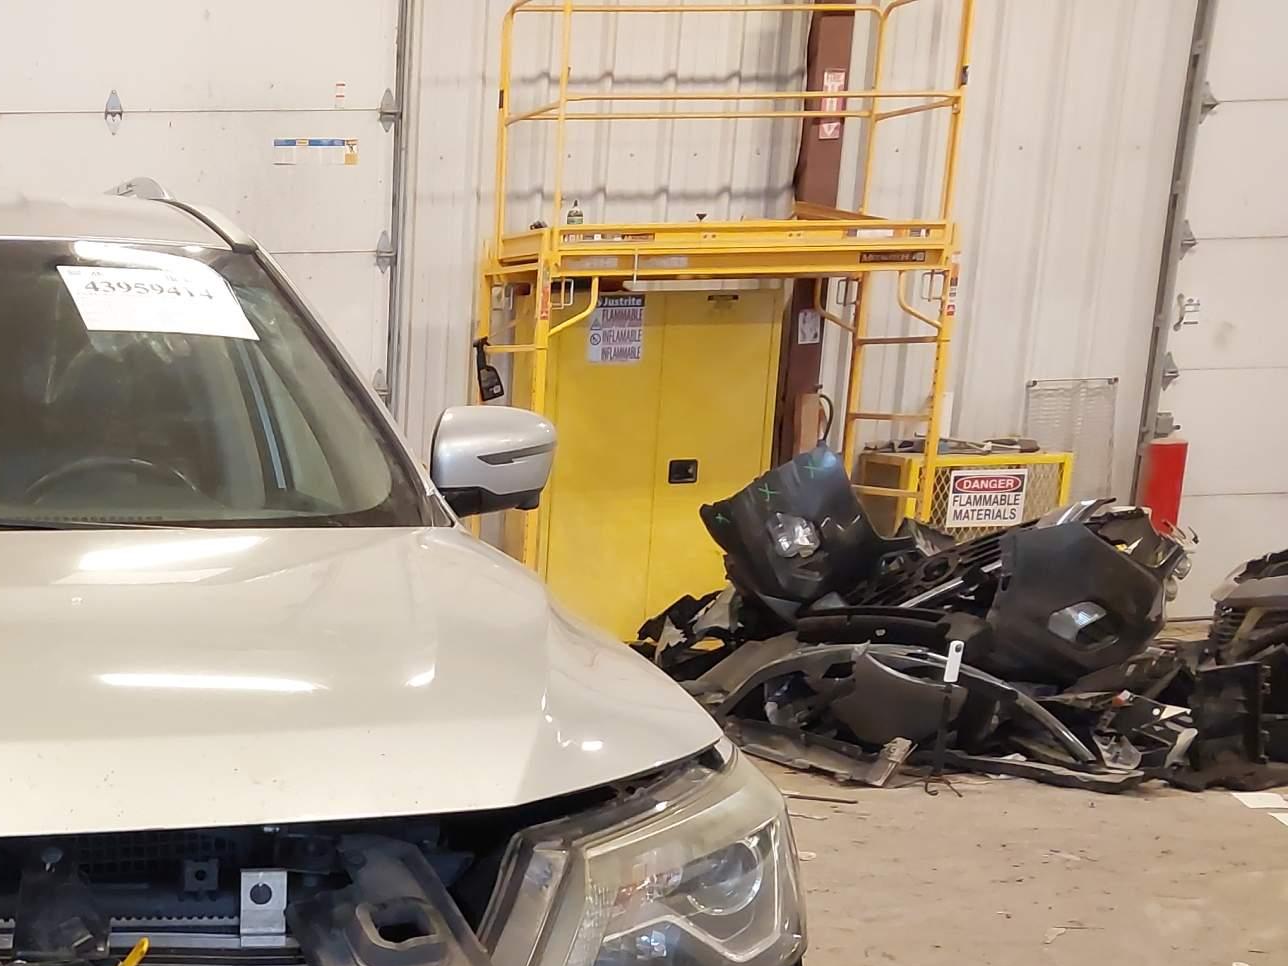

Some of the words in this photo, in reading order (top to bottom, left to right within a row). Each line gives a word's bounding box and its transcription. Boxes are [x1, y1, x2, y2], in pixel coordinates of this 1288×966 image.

[603, 296, 643, 307] Justrite
[963, 478, 1014, 490] DANGER
[952, 493, 1021, 507] FLAMMABLE
[952, 507, 1017, 521] MATERIALS
